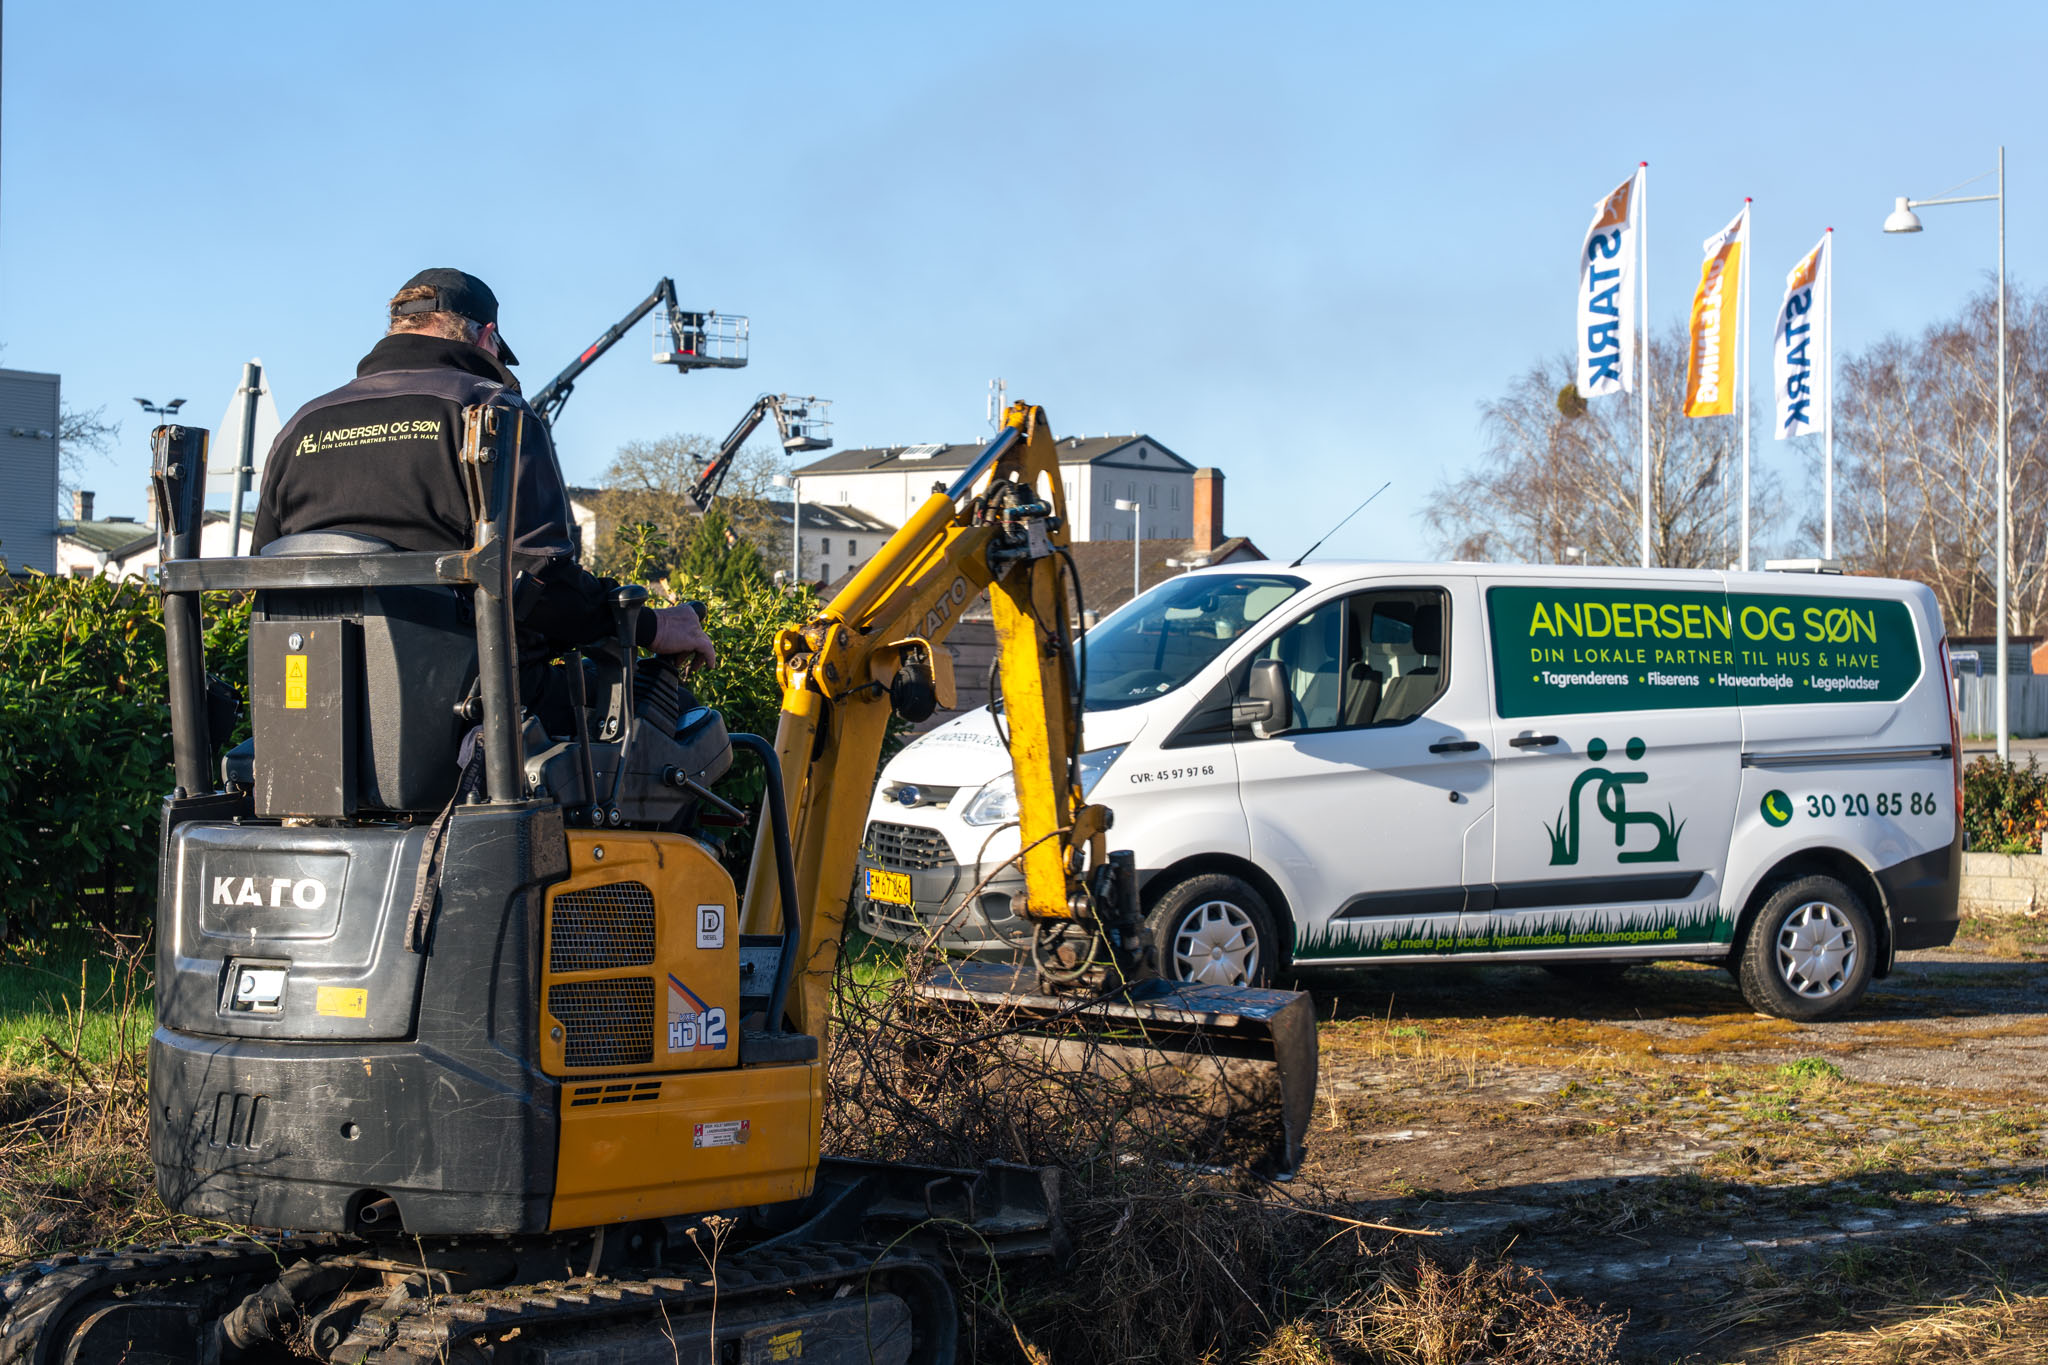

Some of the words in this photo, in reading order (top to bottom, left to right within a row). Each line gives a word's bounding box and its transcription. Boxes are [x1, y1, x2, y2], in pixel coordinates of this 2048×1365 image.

[323, 425, 388, 442] ANDERSEN
[391, 422, 409, 433] OG
[411, 421, 440, 432] SØN
[334, 440, 359, 449] LOKALE
[359, 436, 387, 445] PARTNER
[420, 433, 439, 441] HAVE
[1529, 601, 1731, 639] ANDERSEN
[1739, 605, 1796, 642] OG
[1803, 607, 1878, 644] SØN
[1530, 648, 1564, 664] DIN
[1574, 648, 1646, 664] LOKALE
[1655, 649, 1734, 665] PARTNER
[1741, 651, 1769, 667] TIL
[1776, 652, 1811, 667] HUS
[1818, 652, 1829, 668] &
[1836, 654, 1880, 669] HAVE
[1541, 670, 1629, 688] Tagrenderens
[1647, 671, 1700, 686] Fliserens
[1717, 673, 1794, 691] Havearbejde
[1811, 675, 1881, 692] Legepladser
[1130, 772, 1154, 784] CVR:
[1156, 770, 1169, 781] 45
[1171, 768, 1184, 779] 97
[1187, 767, 1199, 778] 97
[1202, 765, 1215, 776] 68
[1806, 794, 1836, 818] 30
[1843, 793, 1870, 817] 20
[1876, 792, 1903, 817] 85
[1910, 791, 1937, 816] 86
[212, 877, 327, 909] KATO
[1381, 938, 1398, 951] Se
[1400, 938, 1433, 949] mere
[1457, 936, 1490, 948] vores
[1493, 931, 1566, 949] hjemmeside
